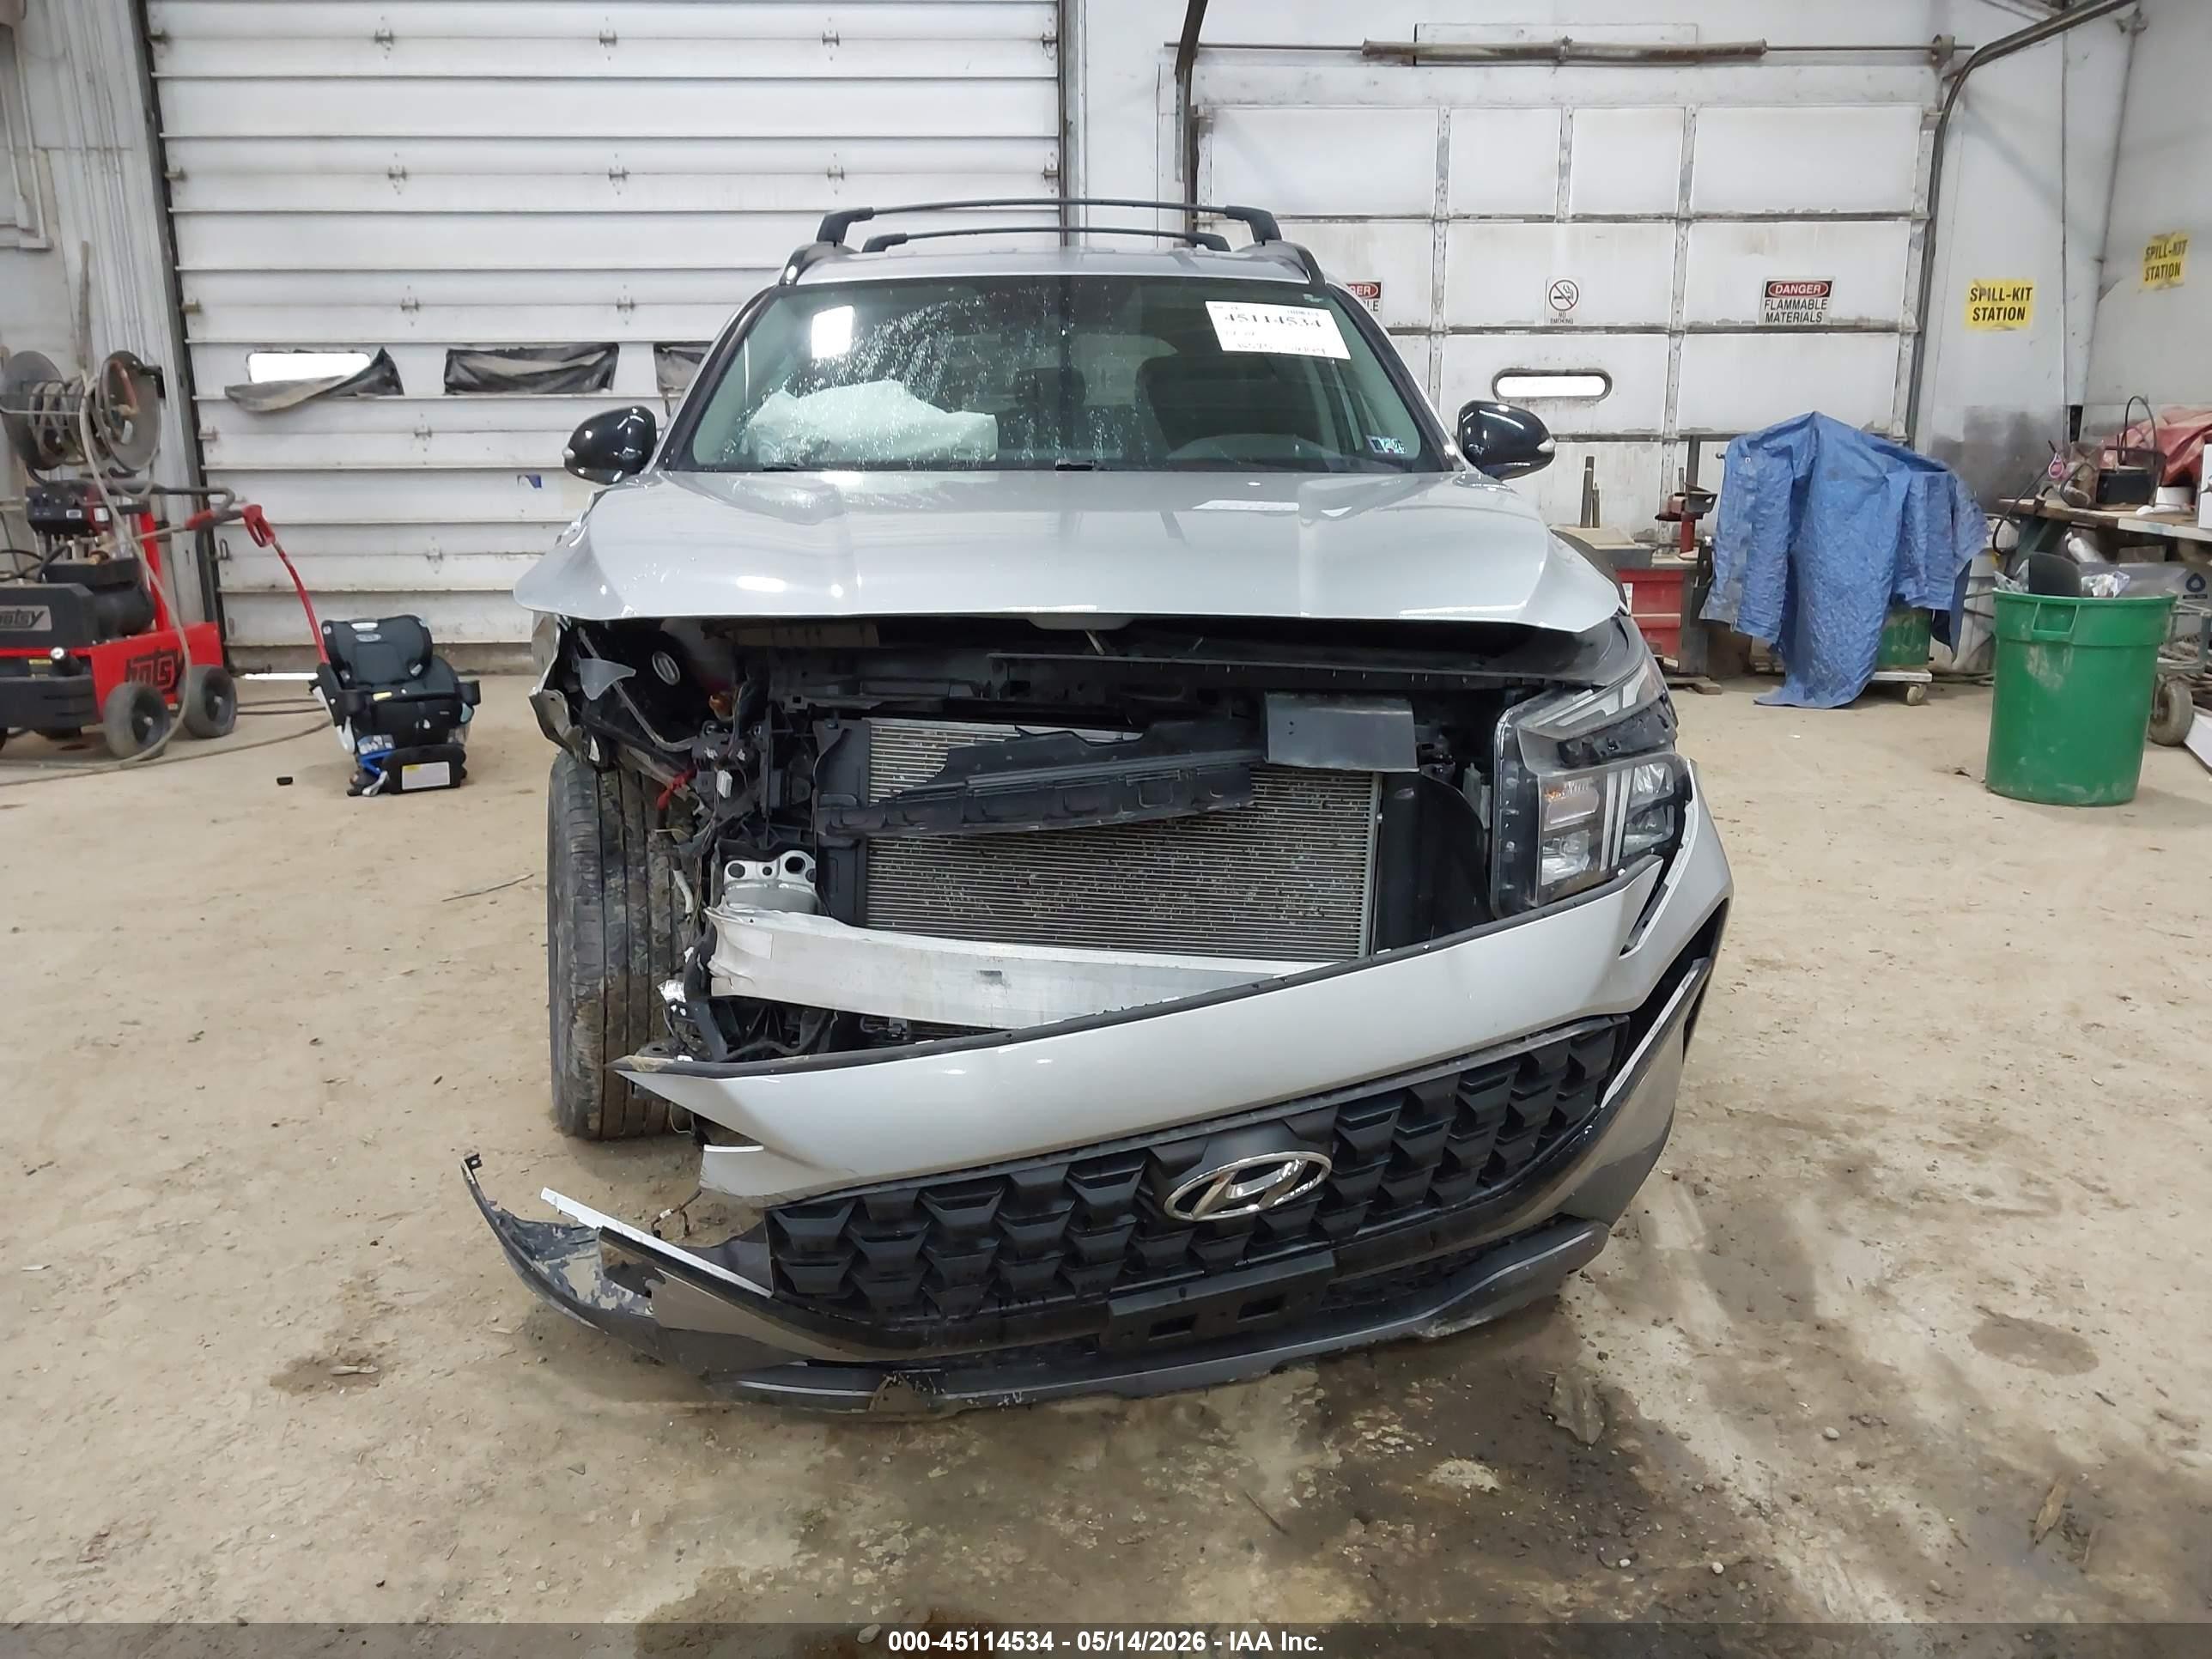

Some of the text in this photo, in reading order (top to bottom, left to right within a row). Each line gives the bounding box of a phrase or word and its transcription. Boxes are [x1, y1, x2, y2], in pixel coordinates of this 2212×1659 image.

[2144, 240, 2188, 262] SPILL-KIT
[2145, 261, 2181, 282] STATION
[1775, 284, 1821, 295] DANGER
[1970, 287, 2033, 302] SPILL-KIT
[1765, 298, 1828, 310] FLAMMABLE
[1224, 313, 1322, 328] 45114534
[1765, 312, 1823, 324] MATERIALS
[1972, 307, 2027, 322] STATION
[0, 609, 45, 629] otsy
